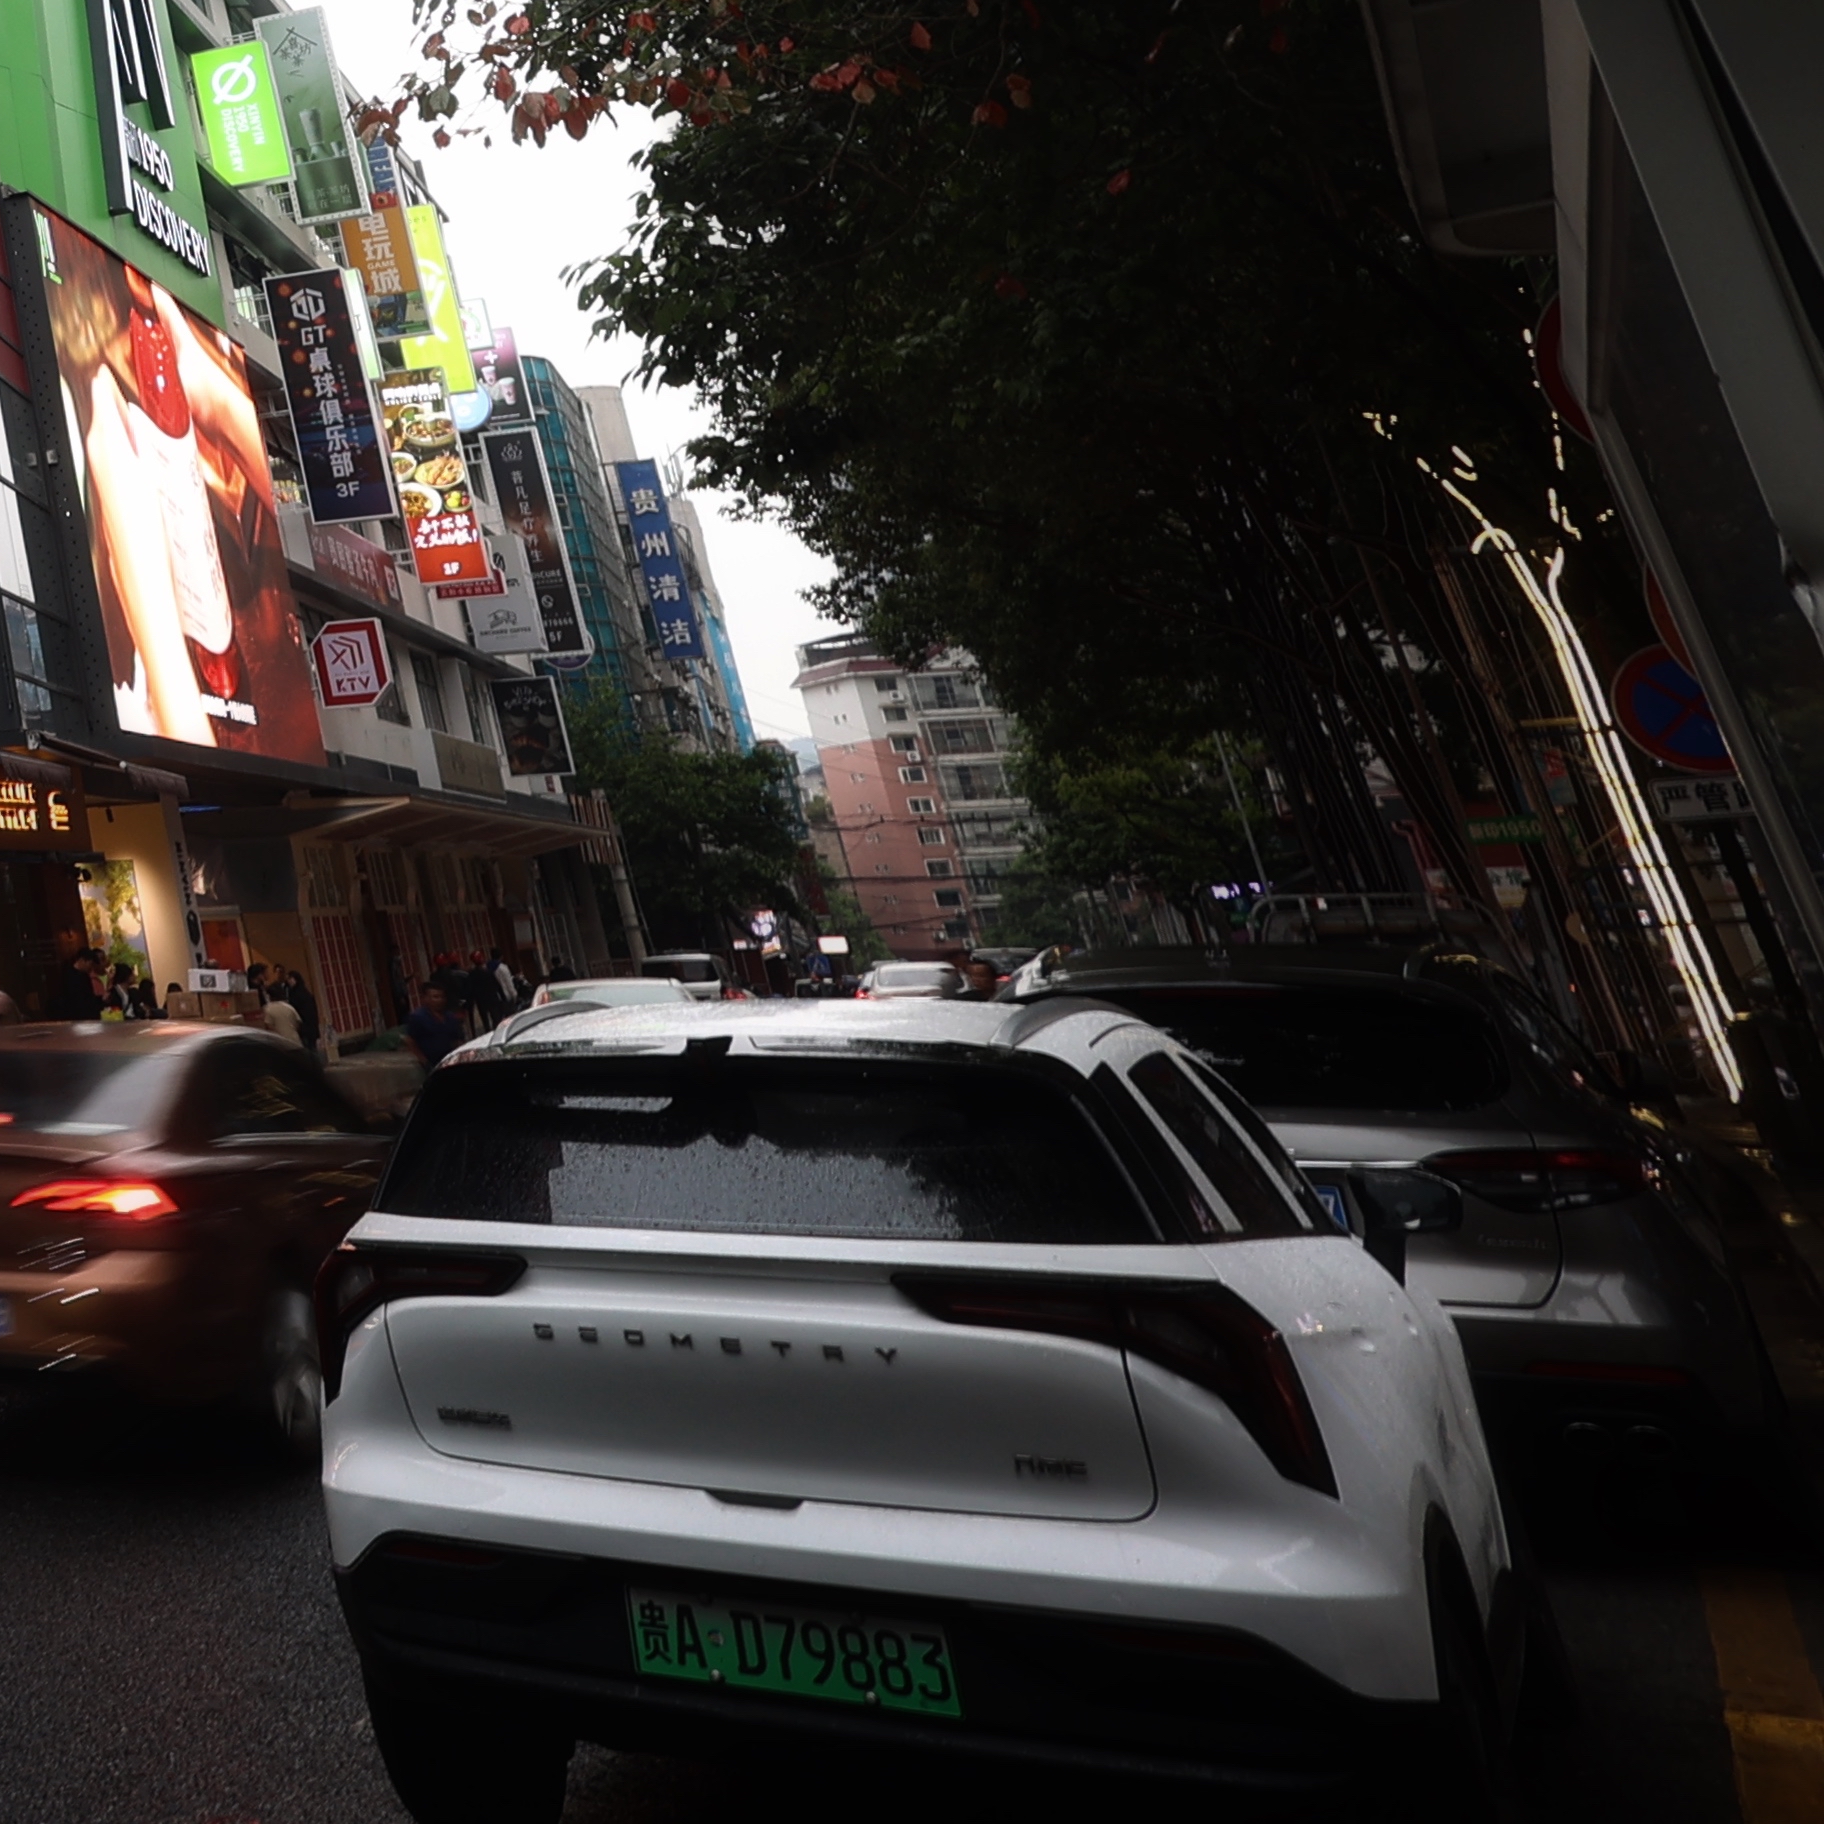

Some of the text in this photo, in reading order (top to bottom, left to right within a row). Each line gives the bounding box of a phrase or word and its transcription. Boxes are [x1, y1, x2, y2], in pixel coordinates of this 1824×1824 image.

[220, 108, 245, 173] DISCOVERY
[233, 106, 245, 133] 1950
[245, 102, 266, 146] XINYIN
[133, 179, 212, 278] DISCOVERY
[367, 258, 396, 271] GAME
[300, 324, 327, 346] GT
[308, 346, 355, 480] 桌球俱乐部
[336, 480, 361, 500] 3F
[629, 487, 693, 646] 贵州清洁
[335, 676, 371, 693] KTV
[532, 1322, 901, 1367] GEOMETRY
